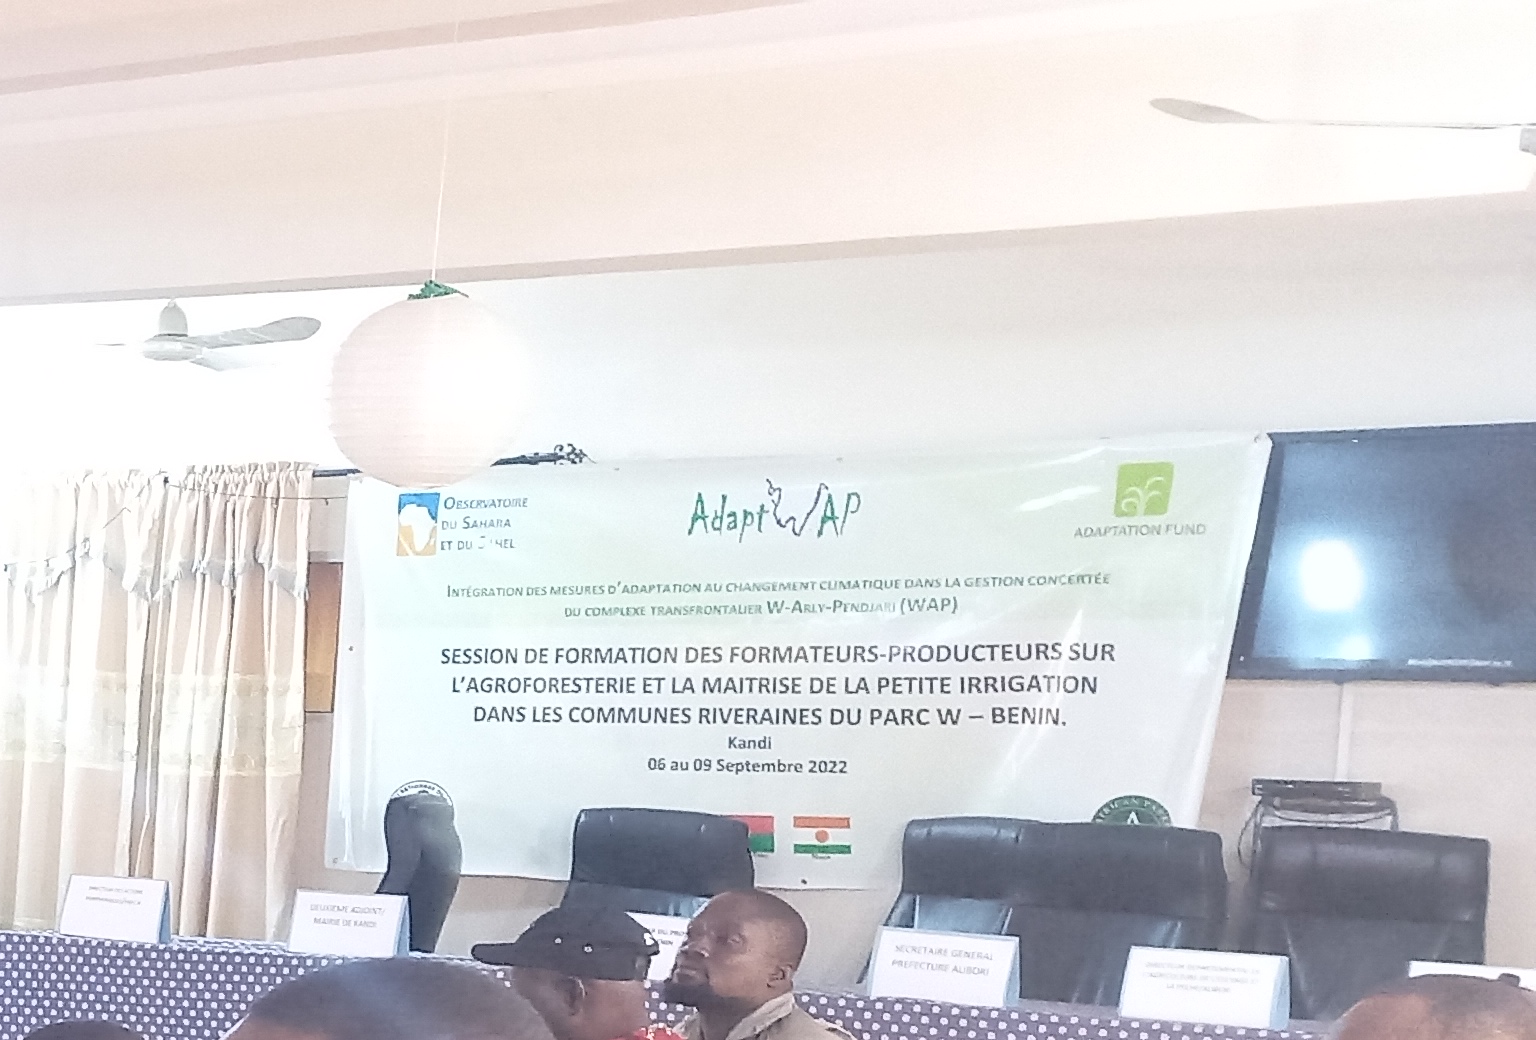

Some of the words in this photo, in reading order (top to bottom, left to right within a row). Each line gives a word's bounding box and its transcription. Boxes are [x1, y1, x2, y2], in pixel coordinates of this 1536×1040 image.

[442, 520, 457, 530] DU
[462, 516, 511, 530] SAHARA
[1074, 524, 1161, 538] ADAPTATION
[1165, 523, 1206, 535] FUND
[440, 540, 453, 550] ET
[458, 540, 472, 550] DU
[526, 585, 548, 597] DES
[550, 584, 606, 596] MESURES
[704, 582, 722, 593] AU
[726, 580, 818, 593] CHANGEMENT
[820, 579, 900, 591] CLIMATIQUE
[904, 578, 942, 589] DANS
[945, 577, 961, 588] LA
[964, 576, 1024, 588] GESTION
[564, 606, 580, 618] DU
[584, 606, 646, 618] COMPLEXE
[650, 604, 762, 616] TRANSFRONTALIER
[900, 596, 958, 614] (WAP)
[441, 647, 518, 664] SESSION
[524, 647, 548, 664] DE
[555, 646, 678, 664] FORMATION
[685, 646, 722, 664] DES
[730, 642, 1062, 664] FORMATEURS-PRODUCTEURS
[1068, 642, 1115, 662] SUR
[452, 676, 636, 694] L'AGROFORESTERIE
[642, 677, 665, 694] ET
[672, 677, 695, 694] LA
[702, 676, 802, 695] MAITRISE
[809, 676, 836, 694] DE
[844, 677, 870, 694] LA
[878, 676, 951, 694] PETITE
[960, 674, 1098, 694] IRRIGATION
[474, 706, 526, 723] DANS
[532, 706, 562, 723] LES
[568, 706, 692, 724] COMMUNES
[698, 707, 822, 726] RIVERAINES
[830, 708, 862, 726] DU
[870, 708, 930, 726] PARC
[937, 708, 962, 726] W
[992, 706, 1067, 728] BENIN.
[728, 736, 772, 750] Kandi
[648, 758, 666, 772] 06
[670, 760, 690, 772] au
[694, 758, 712, 772] 09
[716, 758, 804, 776] Septembre
[808, 760, 848, 774] 2022
[895, 944, 948, 958] SECRETAIRE
[950, 949, 994, 961] GENERAL
[892, 958, 950, 973] PREFECTURE
